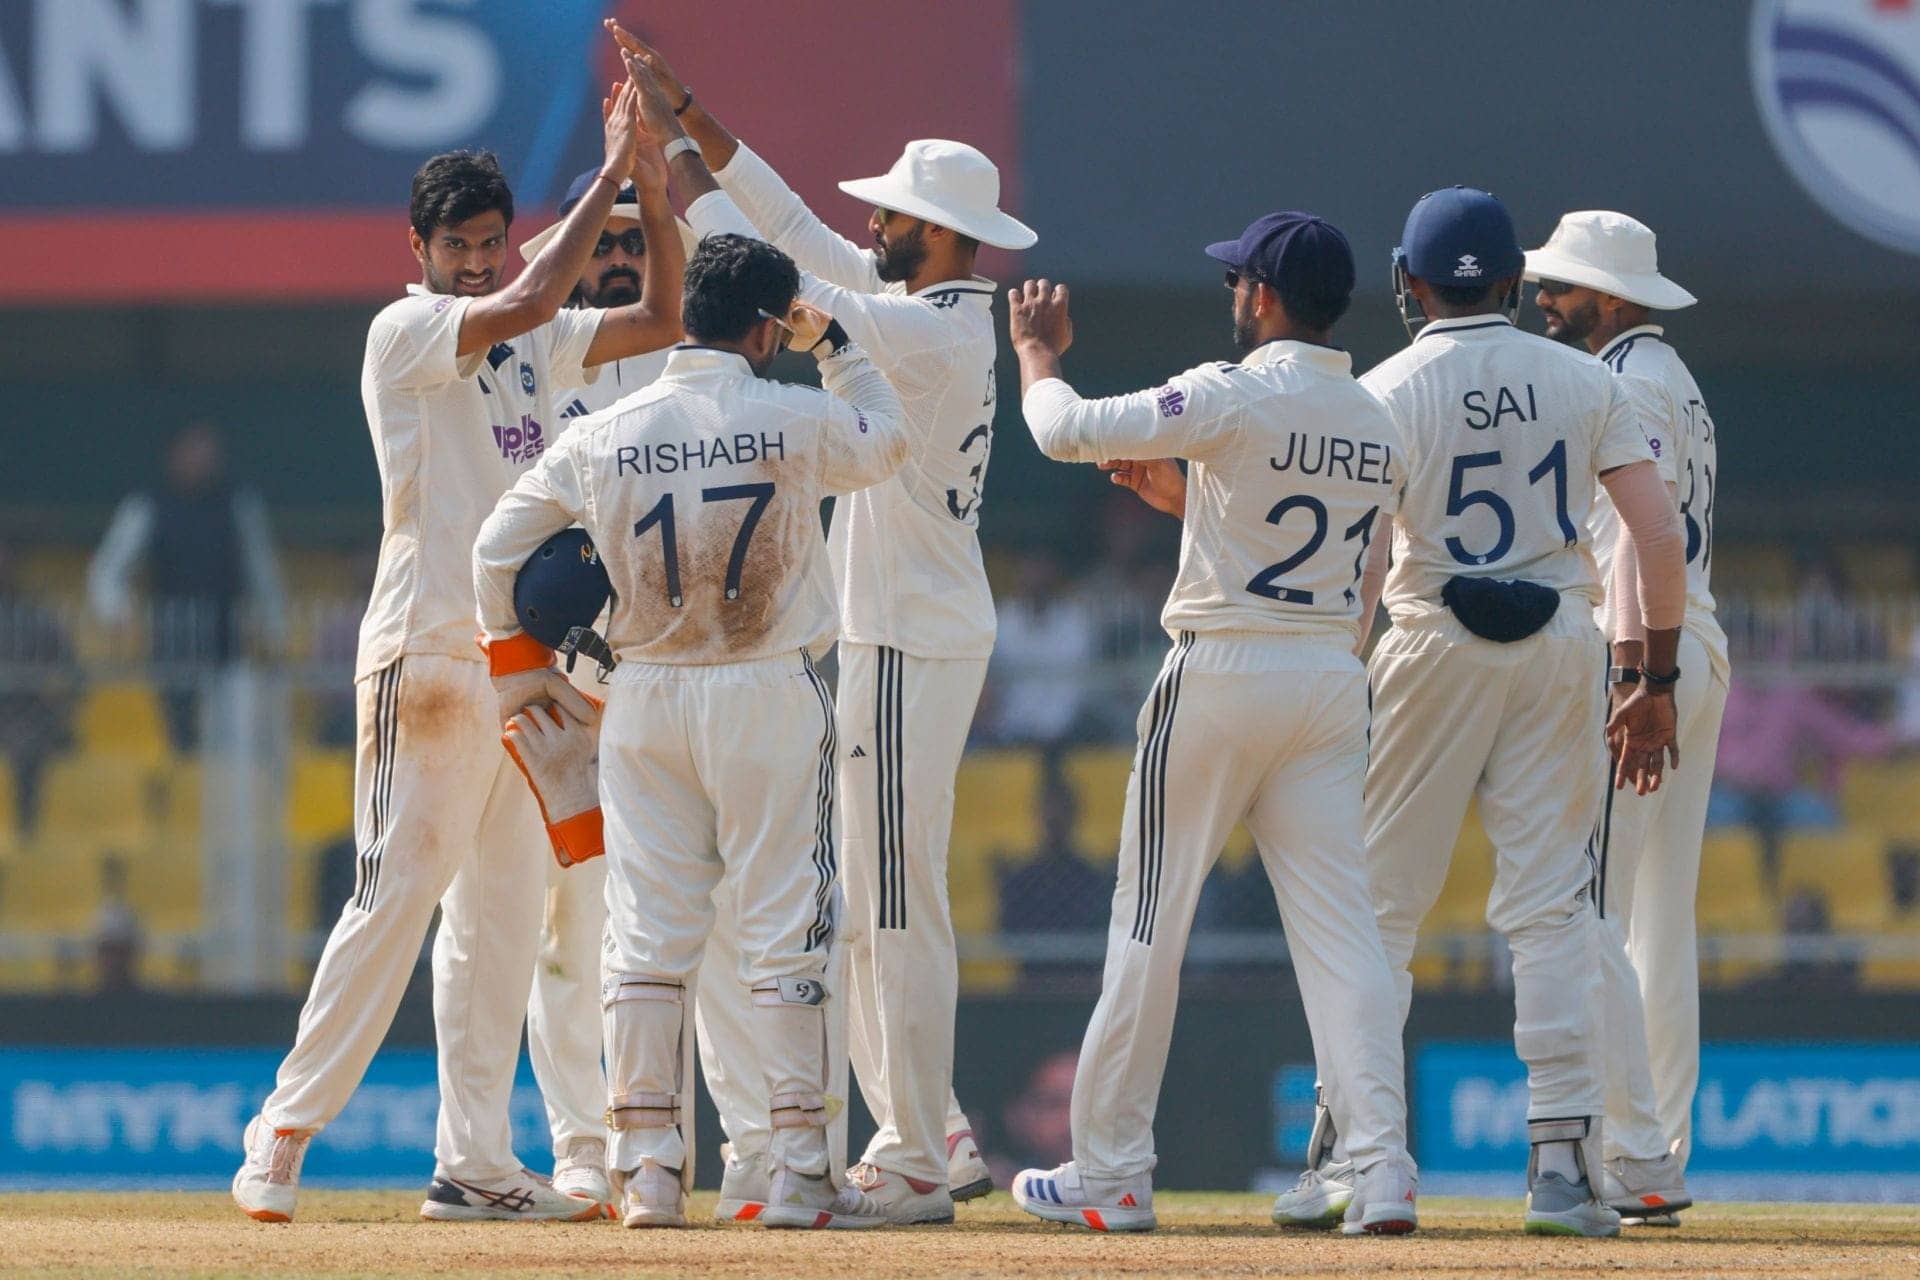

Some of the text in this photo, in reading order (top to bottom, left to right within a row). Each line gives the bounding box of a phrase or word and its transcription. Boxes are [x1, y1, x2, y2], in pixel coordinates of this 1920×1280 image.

[0, 0, 504, 152] NTS
[617, 431, 785, 477] RISHABH
[1270, 432, 1392, 485] JUREL
[1463, 384, 1537, 430] SAI
[634, 482, 776, 607] 17
[1246, 494, 1379, 607] 21
[1445, 439, 1577, 566] 51
